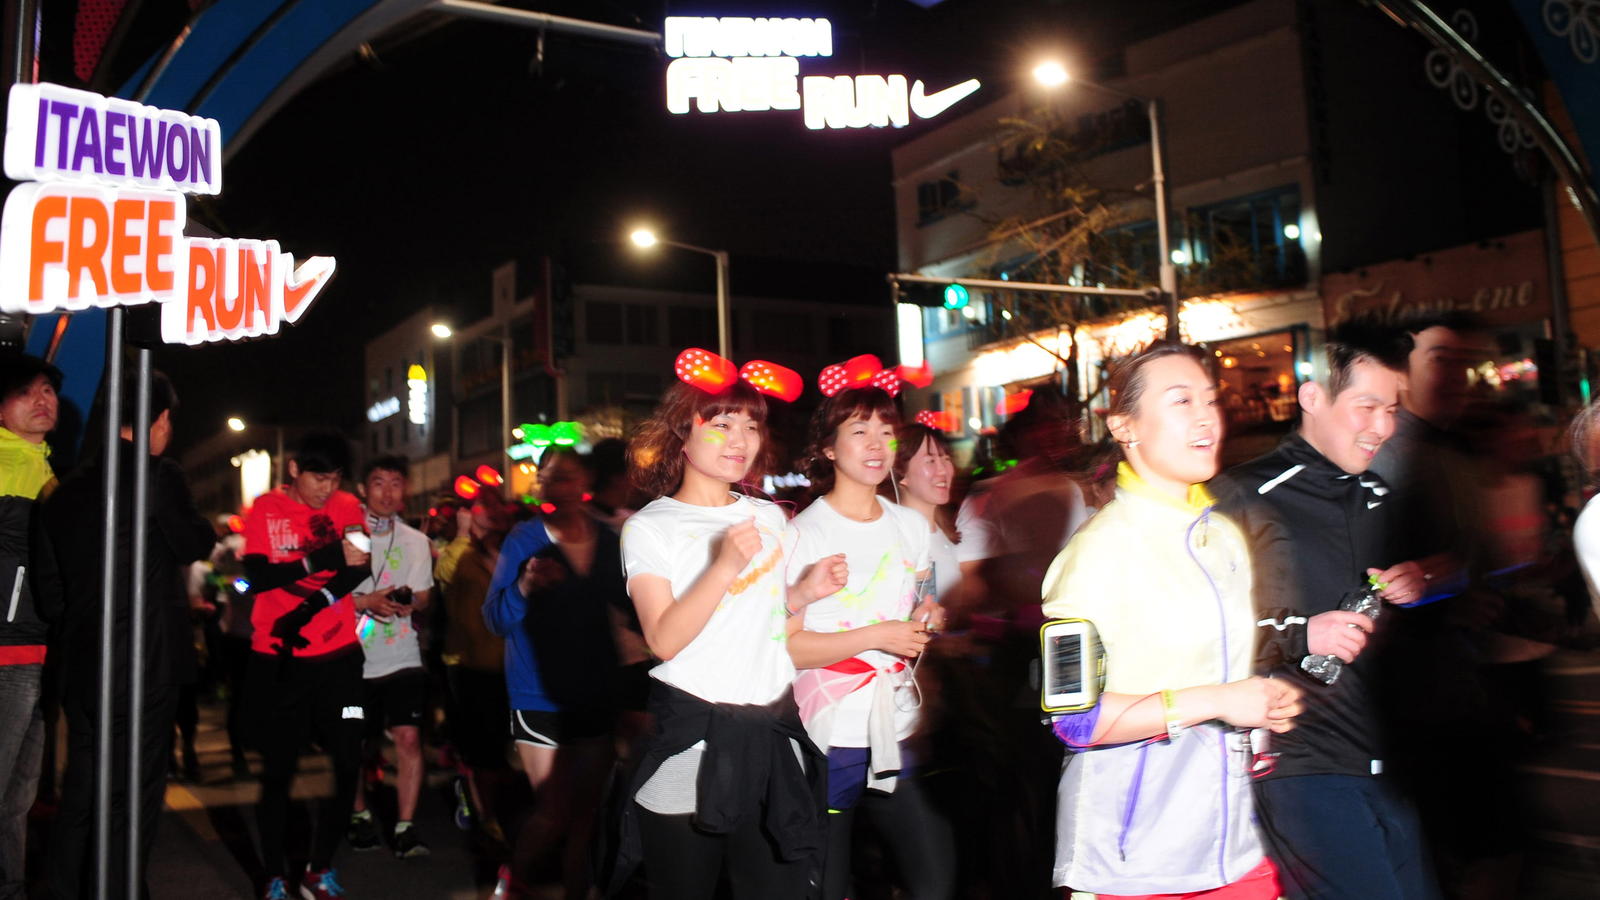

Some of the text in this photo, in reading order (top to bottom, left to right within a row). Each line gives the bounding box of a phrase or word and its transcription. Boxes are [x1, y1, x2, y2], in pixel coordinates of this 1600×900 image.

[802, 74, 910, 130] RUN
[34, 97, 212, 185] ITAEWON
[28, 195, 273, 334] FREE RUN
[266, 518, 292, 535] WE
[270, 533, 299, 550] RUN
